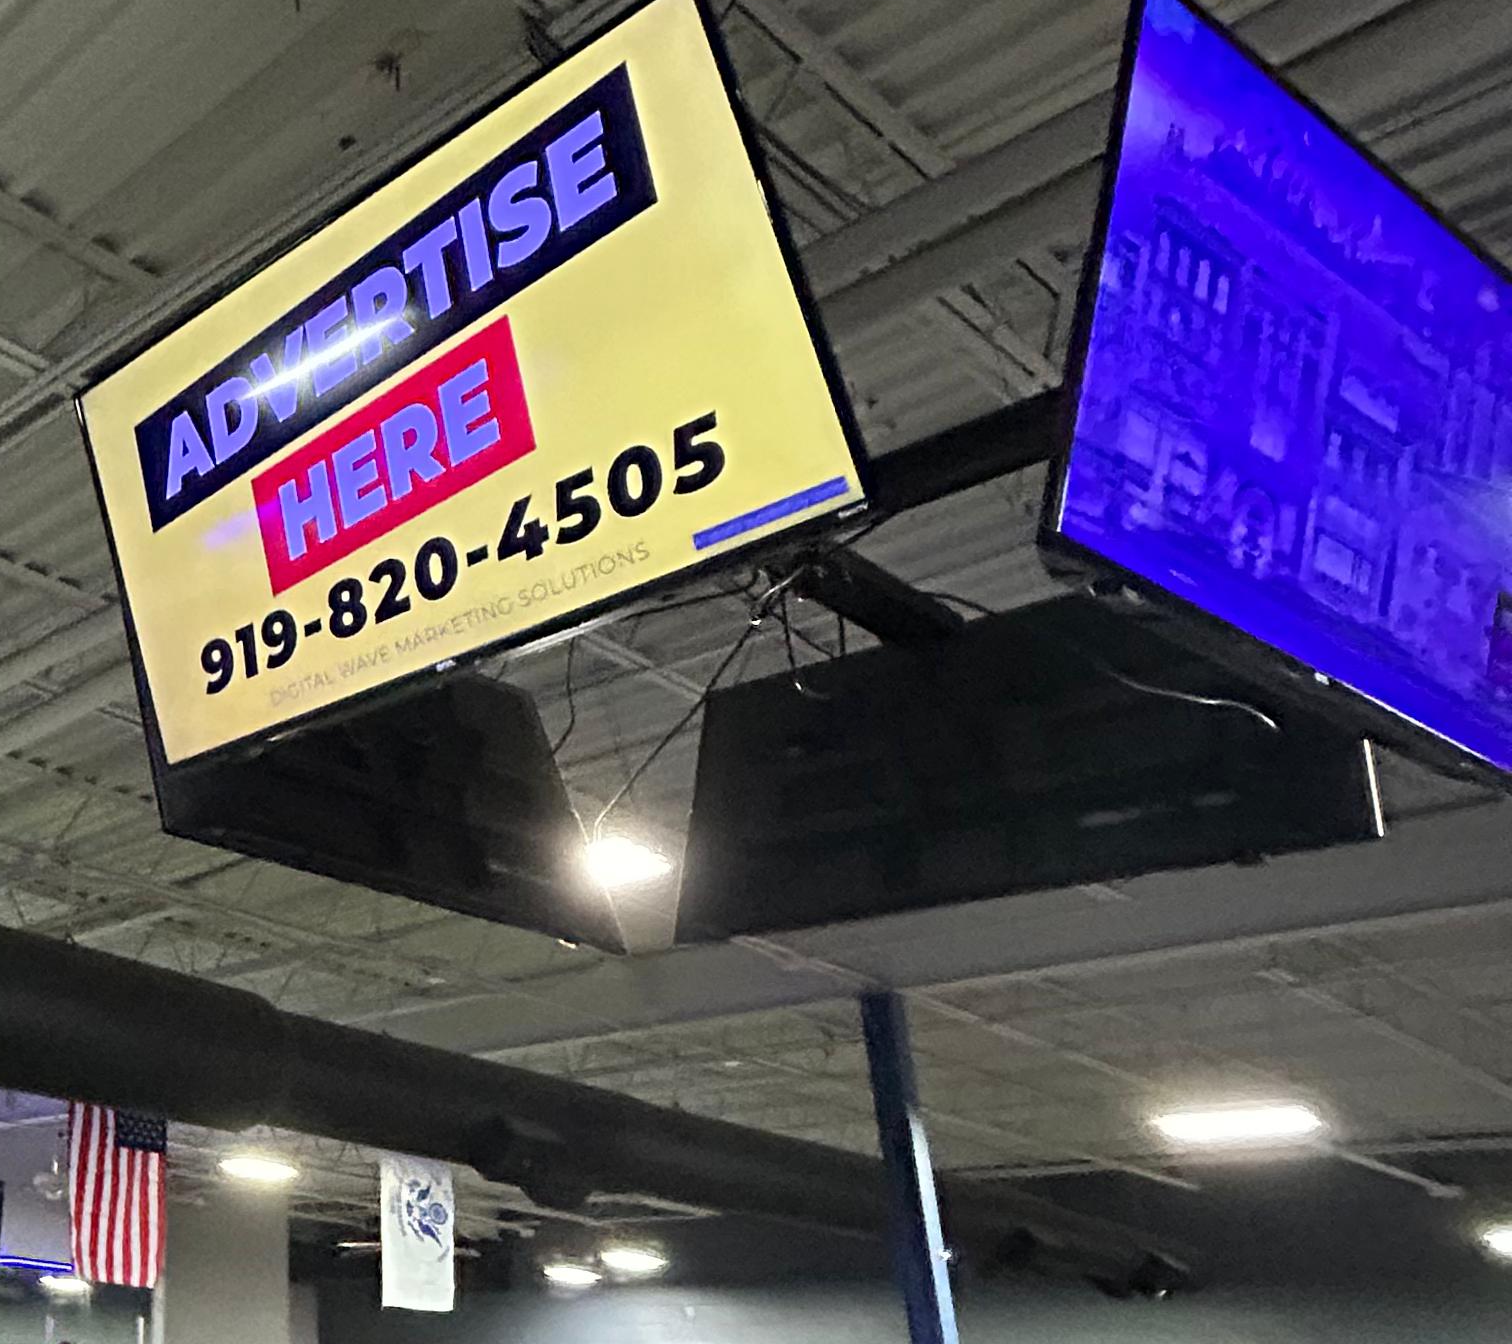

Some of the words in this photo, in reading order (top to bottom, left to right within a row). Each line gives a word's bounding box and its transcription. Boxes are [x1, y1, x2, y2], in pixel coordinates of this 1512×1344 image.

[165, 109, 619, 501] ADVERTISE
[199, 410, 727, 696] 919-820-4505
[276, 357, 502, 562] HERE
[269, 669, 336, 708] DIGITAL
[338, 644, 390, 679] WAVE
[393, 596, 514, 657] MARKETING
[518, 541, 650, 608] SOLUTIONS
